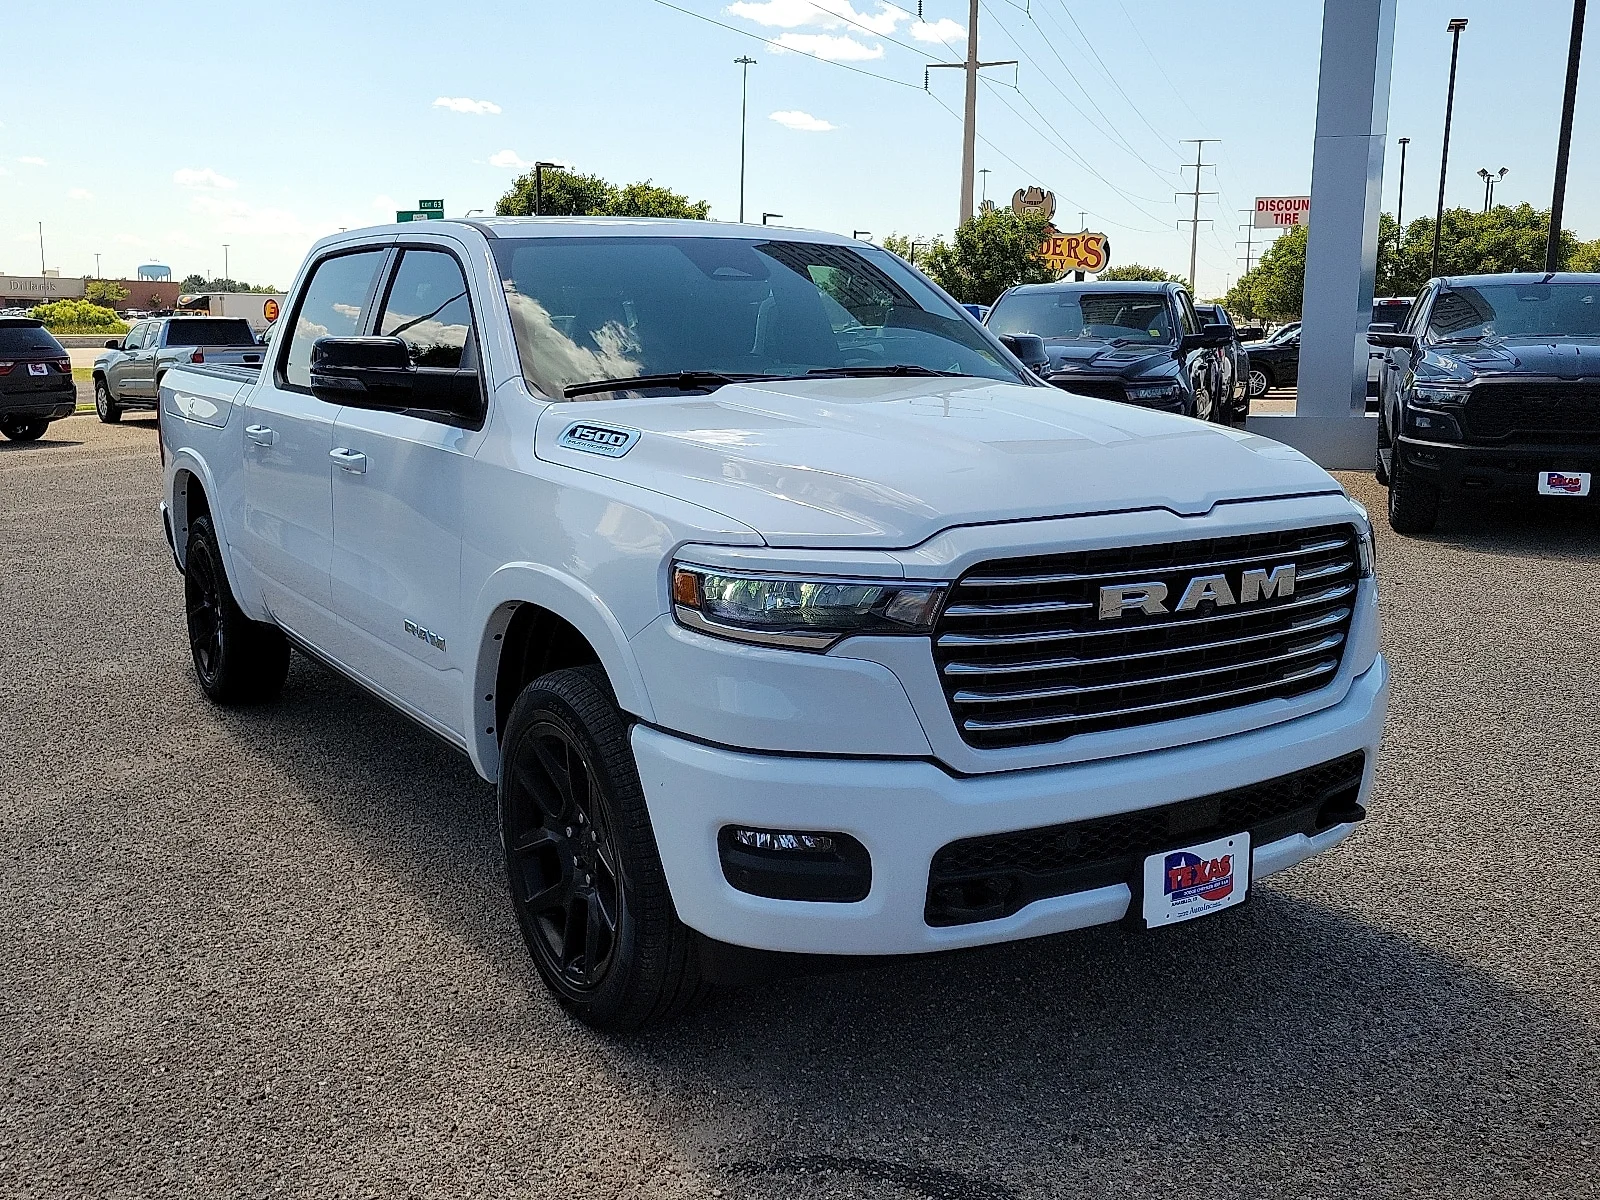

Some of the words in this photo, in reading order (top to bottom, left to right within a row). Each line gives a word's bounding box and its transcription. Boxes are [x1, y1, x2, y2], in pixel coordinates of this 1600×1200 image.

[1257, 199, 1310, 212] DISCOUN
[1273, 212, 1299, 225] TIRE
[1038, 235, 1102, 268] DER'S
[574, 427, 626, 446] 1500
[1099, 563, 1296, 620] RAM
[1168, 855, 1231, 890] TEXAS
